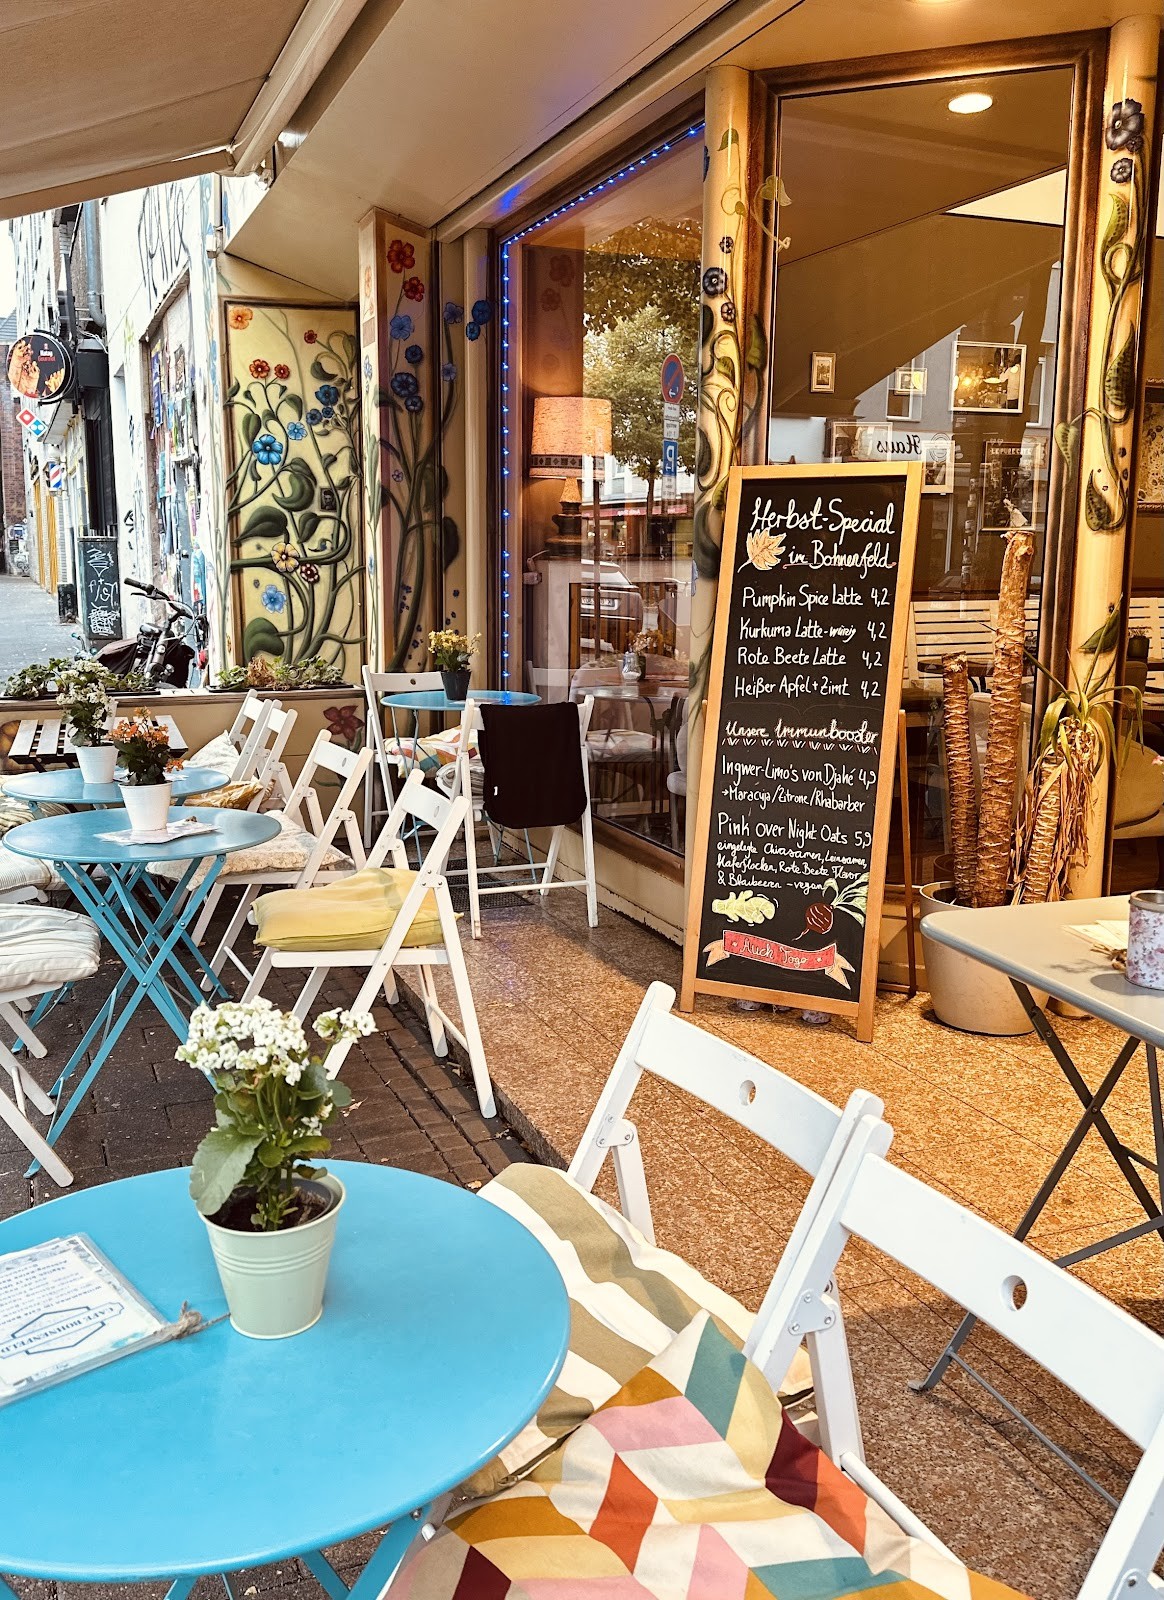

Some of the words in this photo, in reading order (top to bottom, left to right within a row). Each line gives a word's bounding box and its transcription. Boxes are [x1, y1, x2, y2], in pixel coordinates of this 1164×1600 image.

[750, 497, 895, 545] Herbst-Special
[809, 540, 893, 579] Bohnenfeld
[742, 584, 796, 613] Pumpkin
[799, 584, 829, 611] Spice
[832, 583, 863, 605] Latte
[870, 587, 890, 607] 4,2
[740, 616, 791, 640] Kurkuma
[867, 620, 888, 641] 4,2
[737, 646, 770, 665] Rote
[773, 646, 809, 665] Beete
[812, 646, 847, 665] Latte
[861, 650, 882, 669] 4,2
[734, 674, 776, 698] Heißer
[860, 680, 881, 699] 4,2
[725, 720, 770, 737] Unsere
[774, 718, 879, 745] Immunbooster
[722, 754, 799, 787] Ingwer-Limo's
[802, 770, 823, 782] von
[823, 762, 856, 791] Djahé
[718, 812, 750, 836] Pink
[755, 822, 785, 837] over
[788, 817, 817, 848] Night
[820, 824, 848, 844] Oats
[854, 831, 872, 849] 5,9
[717, 870, 726, 886] &
[728, 873, 782, 888] Blaubeeren
[778, 860, 801, 873] Rote
[740, 938, 774, 959] Auch
